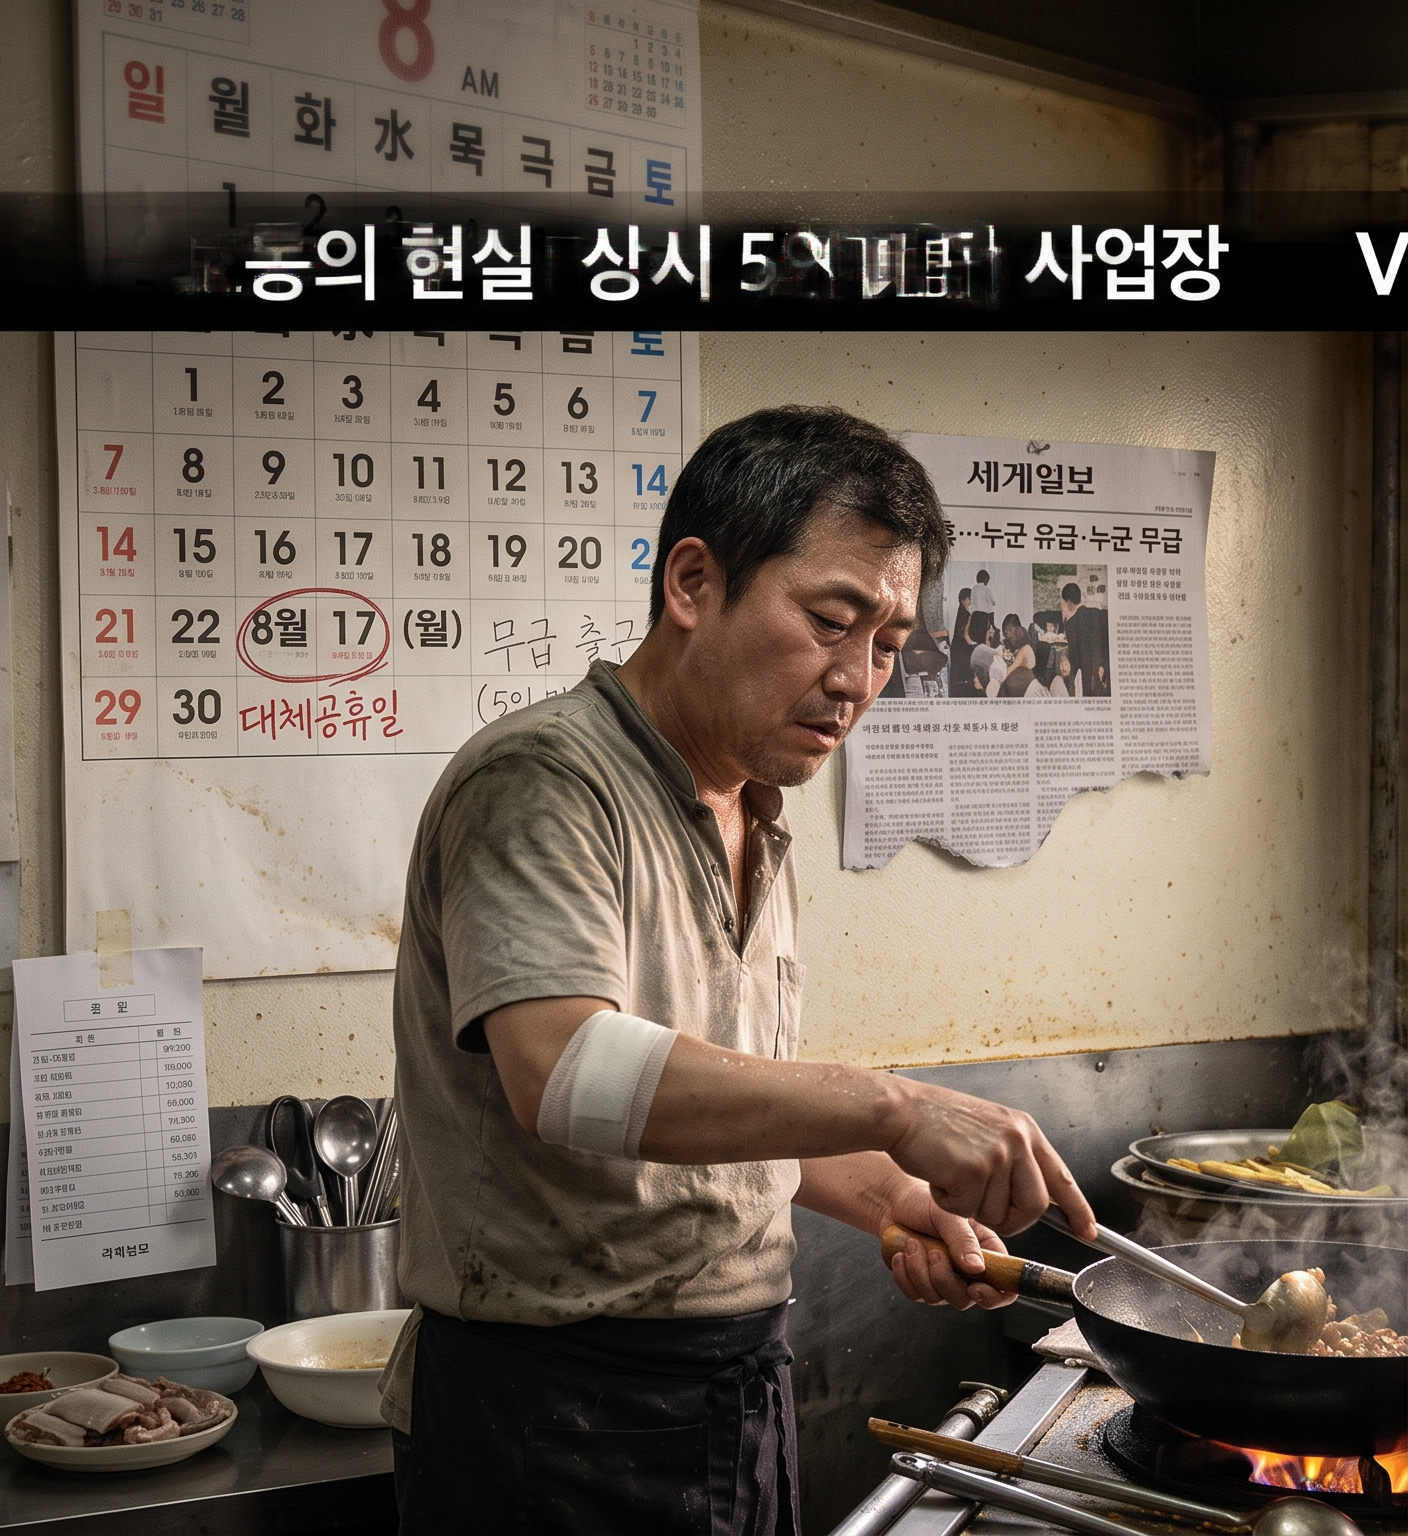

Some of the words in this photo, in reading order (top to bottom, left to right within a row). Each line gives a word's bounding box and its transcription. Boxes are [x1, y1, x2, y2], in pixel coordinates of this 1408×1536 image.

[212, 3, 225, 17] 27
[231, 8, 246, 22] 28
[378, 0, 435, 83] 8
[461, 66, 500, 99] AM
[123, 60, 165, 124] 일
[209, 77, 250, 138] 월
[294, 92, 337, 151] 화
[374, 108, 415, 162] 水
[449, 122, 486, 177] 목
[520, 135, 554, 189] 극
[584, 147, 616, 199] 금
[644, 159, 674, 207] 토
[185, 367, 198, 402] 1
[262, 371, 285, 405] 2
[341, 375, 364, 410] 3
[417, 379, 442, 413] 4
[493, 383, 516, 416] 5
[567, 386, 589, 420] 6
[638, 390, 657, 423] 7
[103, 444, 124, 480] 7
[182, 447, 205, 484] 8
[262, 450, 286, 485] 9
[333, 453, 374, 488] 10
[412, 456, 445, 490] 11
[487, 458, 526, 492] 12
[561, 461, 599, 495] 13
[631, 464, 668, 497] 14
[966, 459, 1095, 496] 세게일보
[97, 526, 137, 562] 14
[173, 528, 216, 564] 15
[254, 530, 296, 565] 16
[334, 531, 373, 566] 17
[412, 533, 451, 567] 18
[487, 534, 527, 568] 19
[558, 536, 602, 569] 20
[631, 538, 650, 570] 2
[1139, 527, 1183, 554] 무급
[95, 608, 134, 644] 21
[171, 609, 221, 644] 22
[251, 608, 308, 648] 8월
[332, 611, 376, 645] 17
[403, 608, 462, 650] (월)
[484, 618, 557, 672] 무급
[94, 689, 142, 725] 29
[172, 689, 222, 725] 30
[239, 689, 403, 741] 대체공휴일
